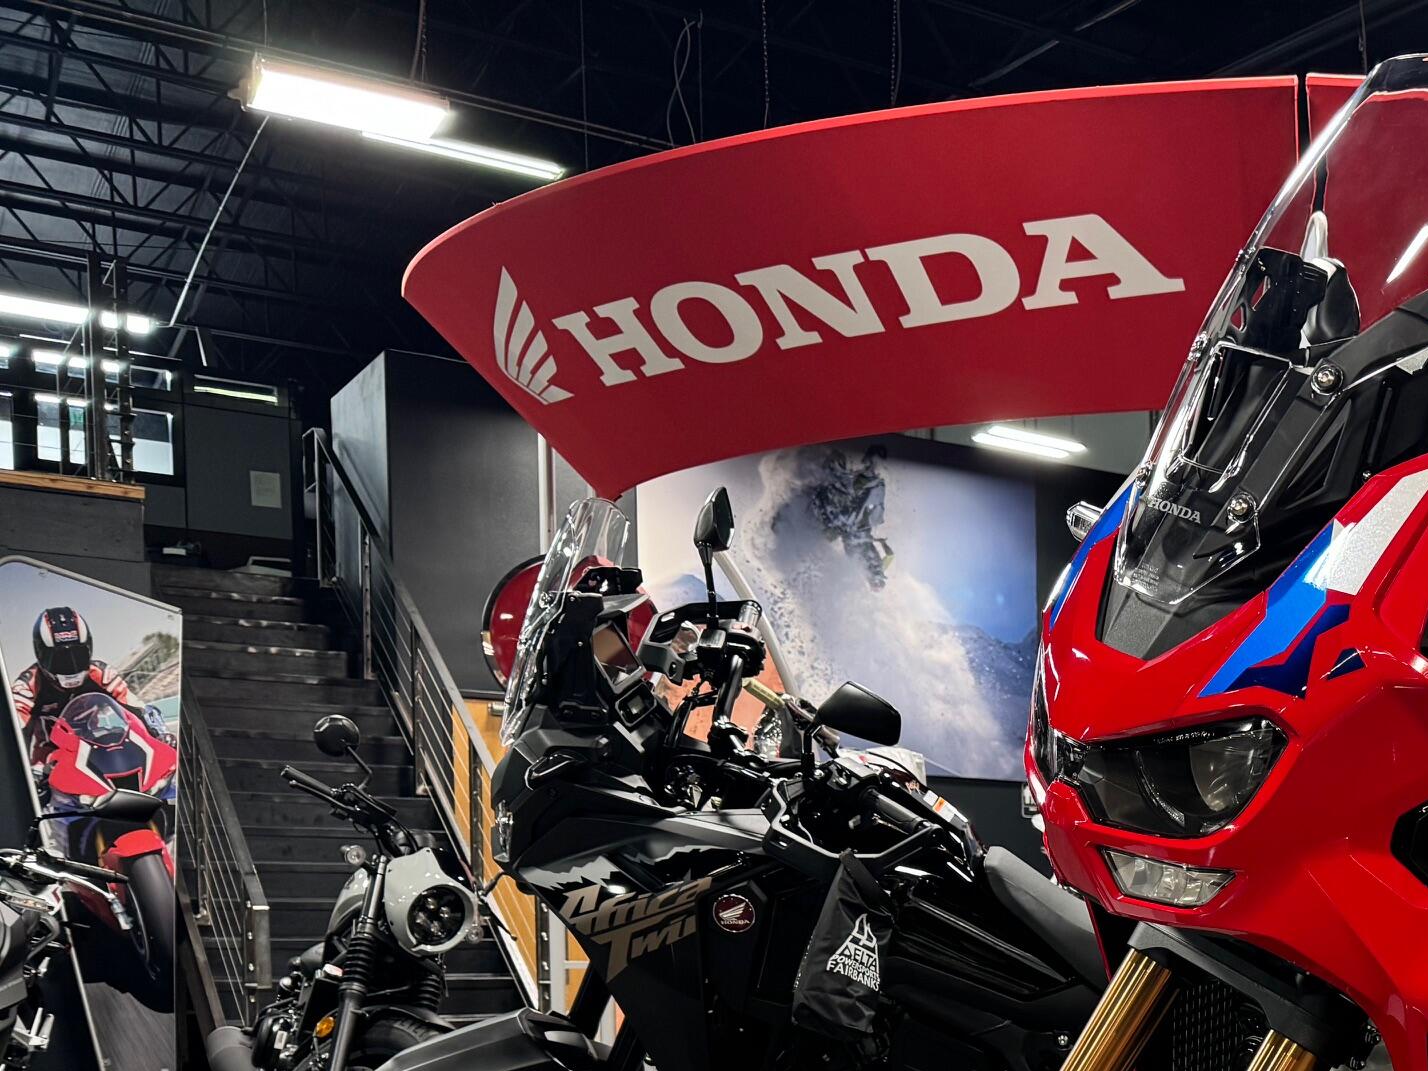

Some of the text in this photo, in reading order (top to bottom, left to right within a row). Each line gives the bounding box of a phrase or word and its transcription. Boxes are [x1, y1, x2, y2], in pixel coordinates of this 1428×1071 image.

[553, 213, 1186, 387] HONDA
[1147, 498, 1201, 524] HONDA
[826, 960, 880, 991] FAIRBANKS
[831, 954, 880, 982] POWERSPORTS
